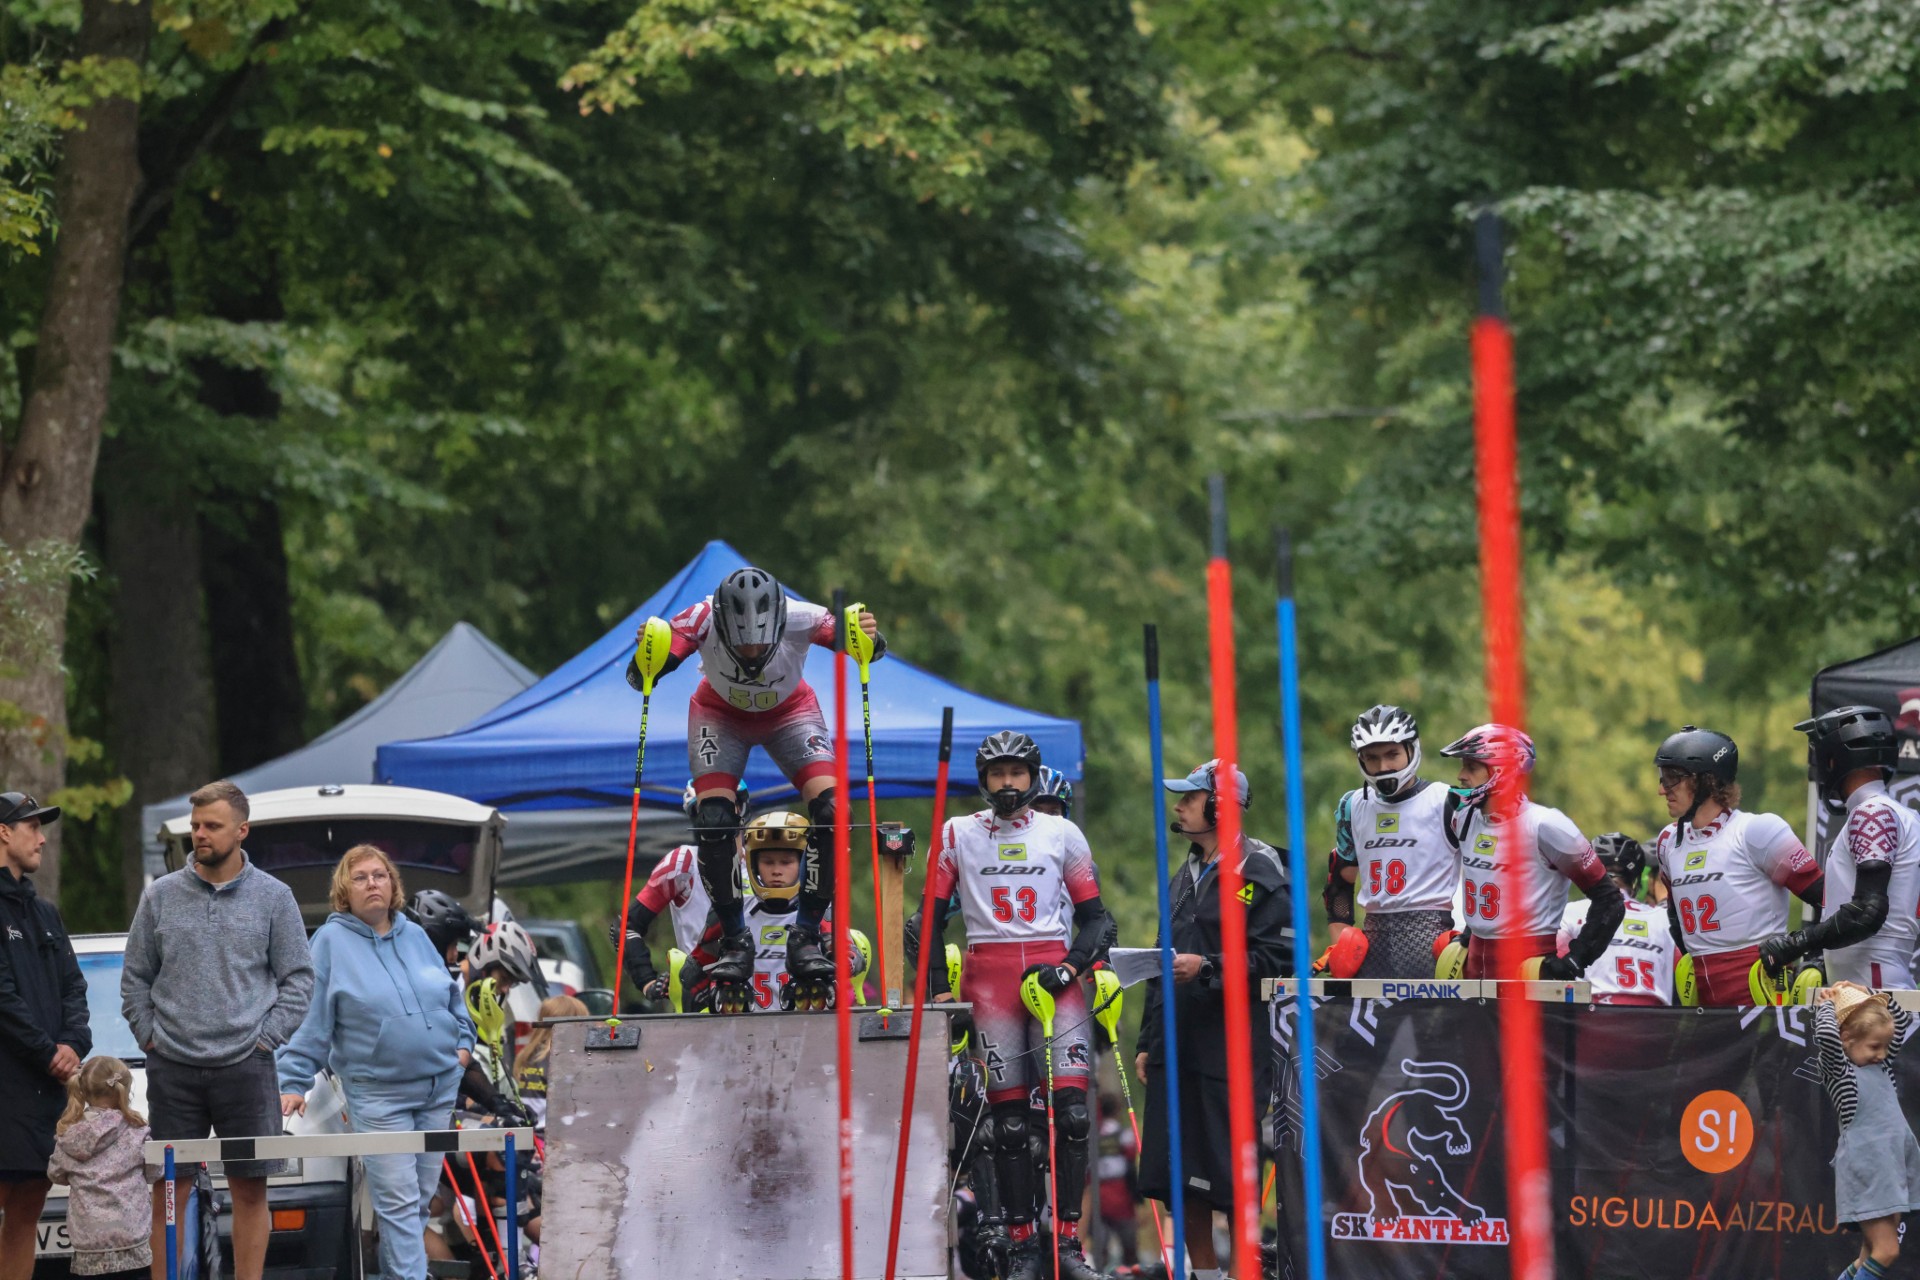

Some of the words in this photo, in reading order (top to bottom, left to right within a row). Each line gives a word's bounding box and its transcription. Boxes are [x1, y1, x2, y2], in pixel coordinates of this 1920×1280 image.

[645, 634, 653, 661] LEKI
[849, 622, 860, 649] LEKI
[728, 686, 779, 710] 50
[700, 727, 718, 765] LAT
[1363, 837, 1418, 850] elan
[980, 864, 1047, 876] elan
[1462, 855, 1513, 872] elan
[1369, 858, 1407, 897] 58
[1671, 871, 1725, 888] elan
[990, 886, 1038, 924] 53
[1464, 878, 1501, 920] 63
[1679, 893, 1721, 935] 62
[1609, 938, 1665, 954] elan
[950, 963, 959, 987] LEK
[1448, 960, 1461, 980] LEK
[1615, 956, 1656, 992] 55
[753, 971, 790, 1009] 51
[1028, 982, 1040, 1007] LEKI
[1100, 983, 1109, 1002] EKI
[1382, 983, 1461, 999] POLANIK
[1684, 973, 1694, 999] LEKI
[1792, 985, 1801, 1005] EKI
[980, 1032, 1005, 1082] LAT
[1695, 1109, 1738, 1154] S!
[1334, 1215, 1368, 1237] SK
[1372, 1218, 1507, 1242] PANTERA
